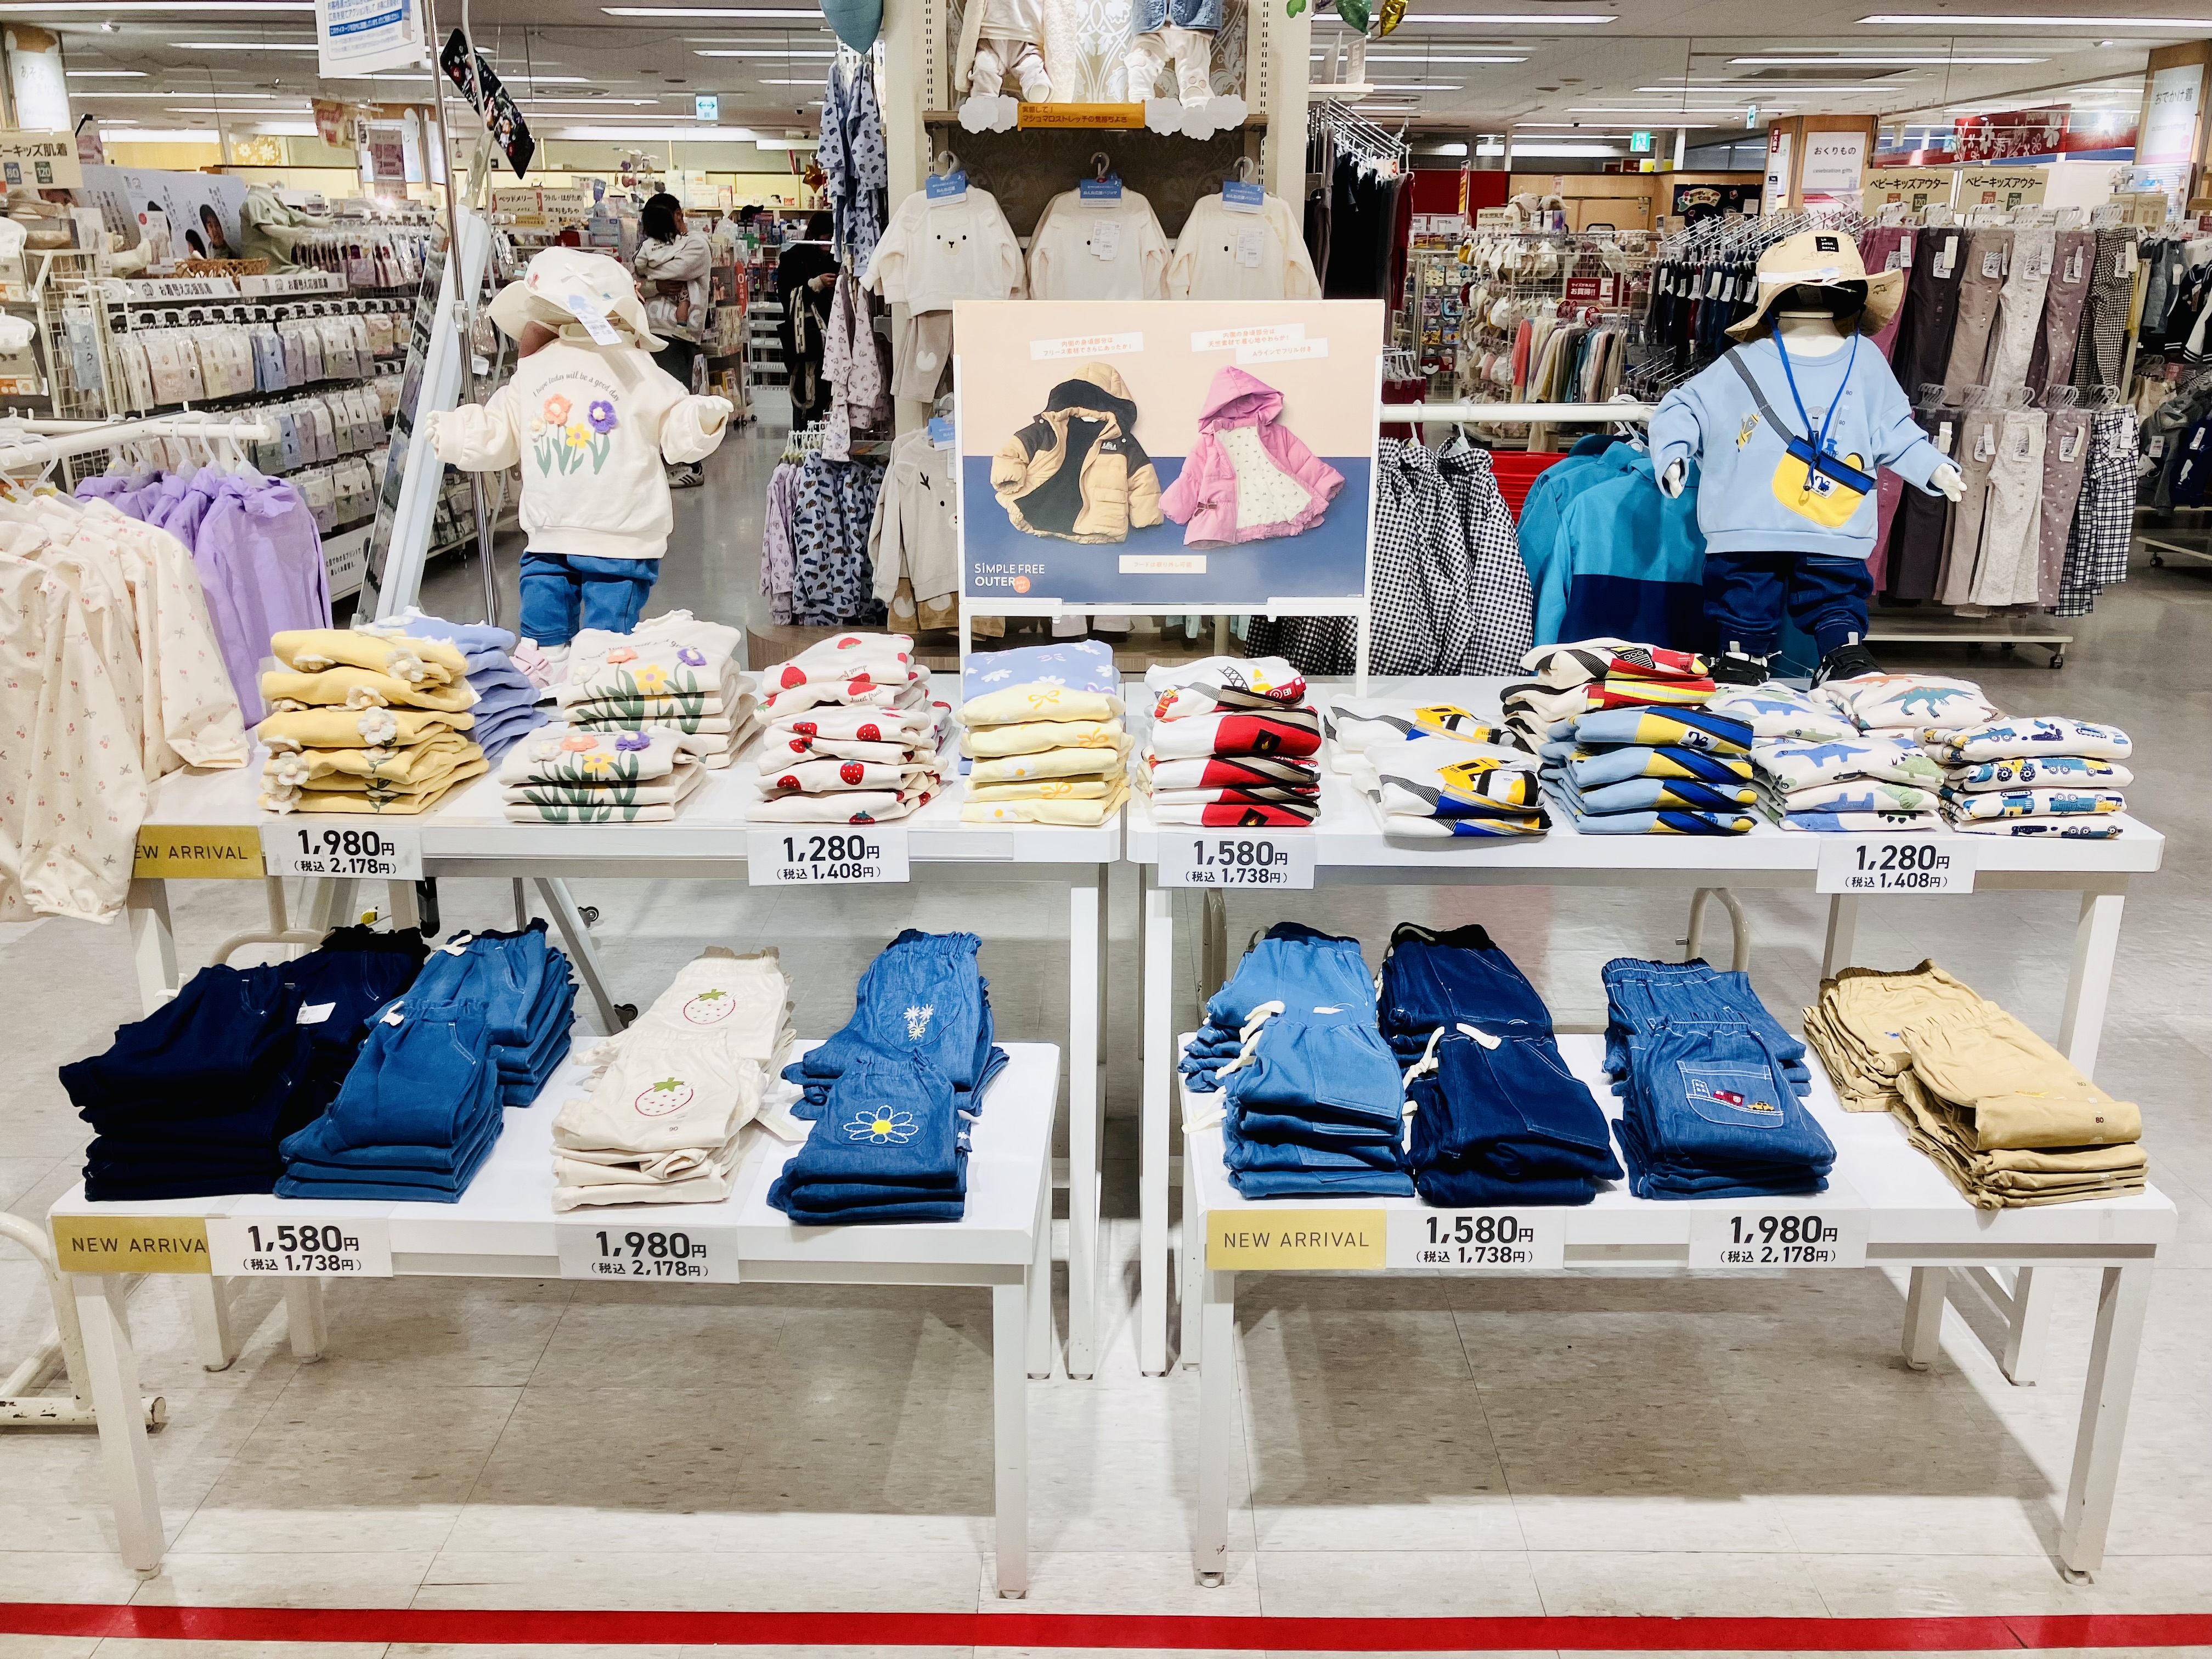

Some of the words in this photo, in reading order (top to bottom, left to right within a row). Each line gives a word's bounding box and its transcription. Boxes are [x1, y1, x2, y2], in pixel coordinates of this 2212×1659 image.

[2155, 87, 2193, 105] おでかけ着
[1814, 146, 1857, 155] おくりもの
[37, 167, 50, 177] 120
[1870, 178, 1949, 189] ベビーキッズアウター
[1966, 176, 2042, 189] ベビーキッズアウター
[544, 194, 582, 202] ラトル・はがため
[1208, 335, 1289, 347] 天竺素材で着心地やわらか!
[1223, 329, 1275, 338] 内側の身頃部分は
[1043, 343, 1131, 356] フリース素材でさらにあったか!
[1061, 337, 1113, 347] 内側の身頃部分は
[1252, 346, 1311, 357] Aラインでフリル付き
[536, 381, 548, 394] hope
[549, 374, 564, 384] today
[566, 371, 579, 379] will
[580, 372, 588, 381] be
[593, 380, 611, 392] good
[609, 389, 619, 402] day
[1018, 564, 1045, 574] FREE
[974, 575, 1015, 586] OUTER
[298, 829, 395, 856] 1,980円
[783, 835, 879, 862] 1,280円
[134, 846, 159, 860] EW
[169, 845, 249, 860] ARRIVAL
[1194, 840, 1288, 866] 1,580円
[1857, 845, 1950, 870] 1,280円
[295, 860, 325, 872] （税込
[330, 858, 396, 874] 2,178円）
[777, 868, 808, 879] （税込
[812, 863, 881, 879] 1,408円）
[1186, 871, 1215, 883] （税込
[1222, 868, 1287, 883] 1,738円）
[1845, 876, 1875, 888] （税込
[1880, 873, 1948, 888] 1,408円）
[1426, 1216, 1534, 1244] 1,580円
[1731, 1216, 1838, 1244] 1,980円
[72, 1237, 118, 1252] NEW
[129, 1238, 207, 1254] ARRIVA
[247, 1226, 359, 1252] 1,580円
[596, 1231, 707, 1259] 1,980円
[1224, 1232, 1271, 1248] NEW
[1280, 1232, 1369, 1248] ARRIVAL
[1415, 1250, 1451, 1263] （税込
[1458, 1246, 1534, 1264] 1,738円）
[1720, 1250, 1754, 1263] （税込
[1760, 1246, 1836, 1263] 2,178円）
[242, 1258, 278, 1271] （税込
[285, 1255, 362, 1271] 1,738円）
[591, 1262, 626, 1274] （税込
[632, 1260, 708, 1277] 2,178円）
